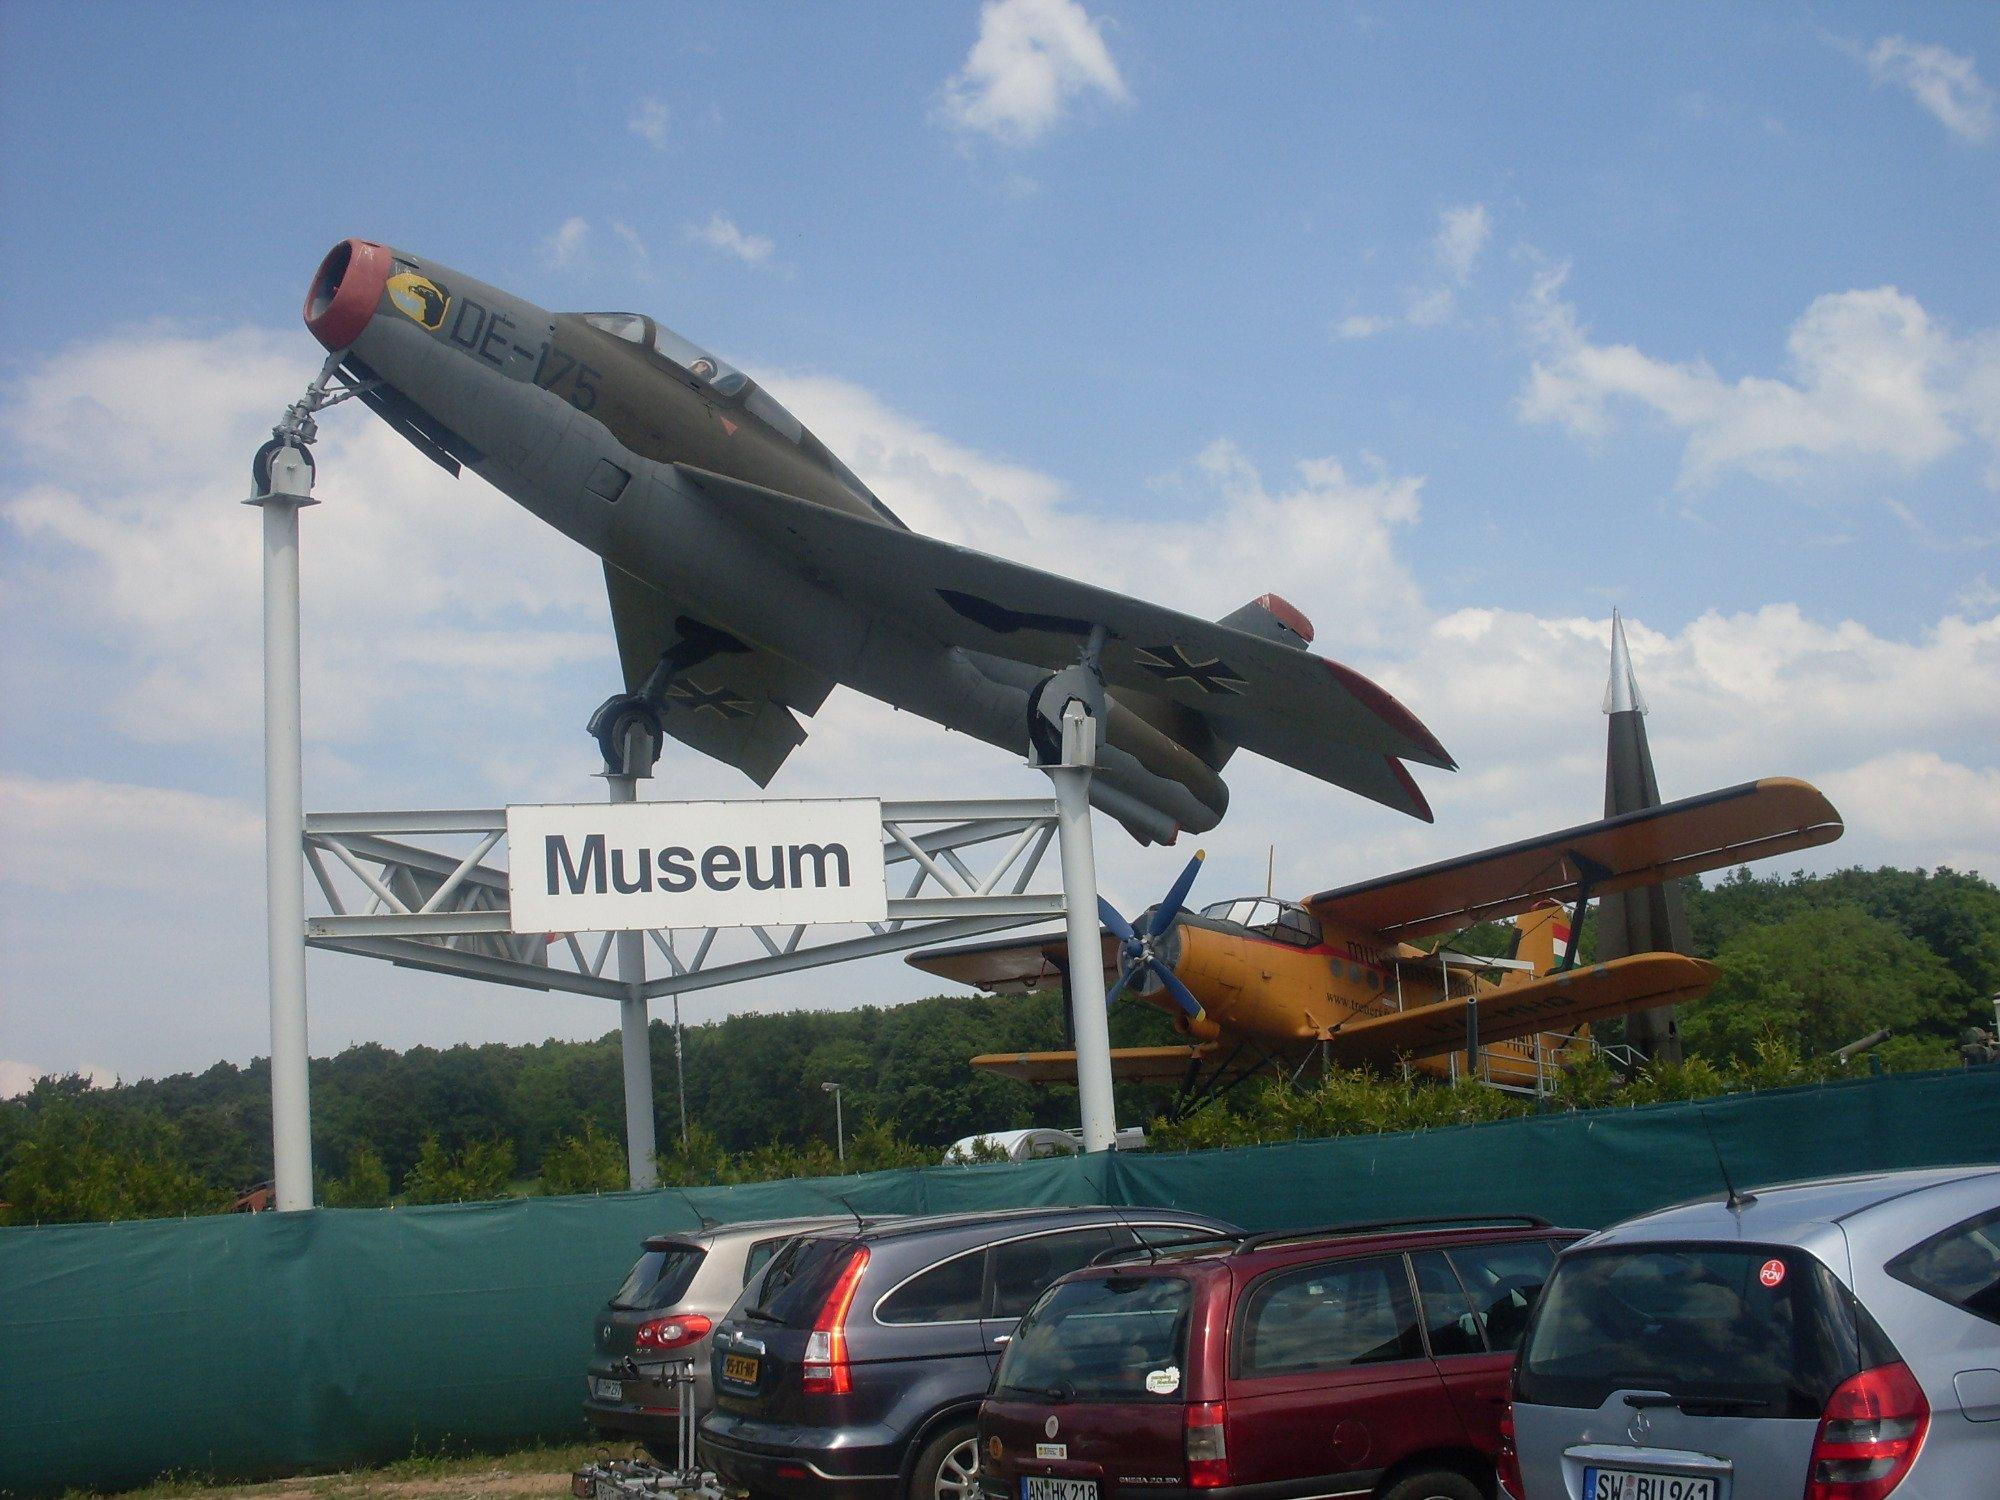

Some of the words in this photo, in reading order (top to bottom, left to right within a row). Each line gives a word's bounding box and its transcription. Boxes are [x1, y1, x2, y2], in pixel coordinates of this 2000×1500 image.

[450, 297, 603, 412] DE-175
[545, 833, 851, 896] Museum
[1029, 1480, 1044, 1500] AN
[1051, 1482, 1067, 1500] HK
[1071, 1483, 1096, 1500] 218
[1596, 1474, 1624, 1500] SW
[1637, 1477, 1665, 1500] BU
